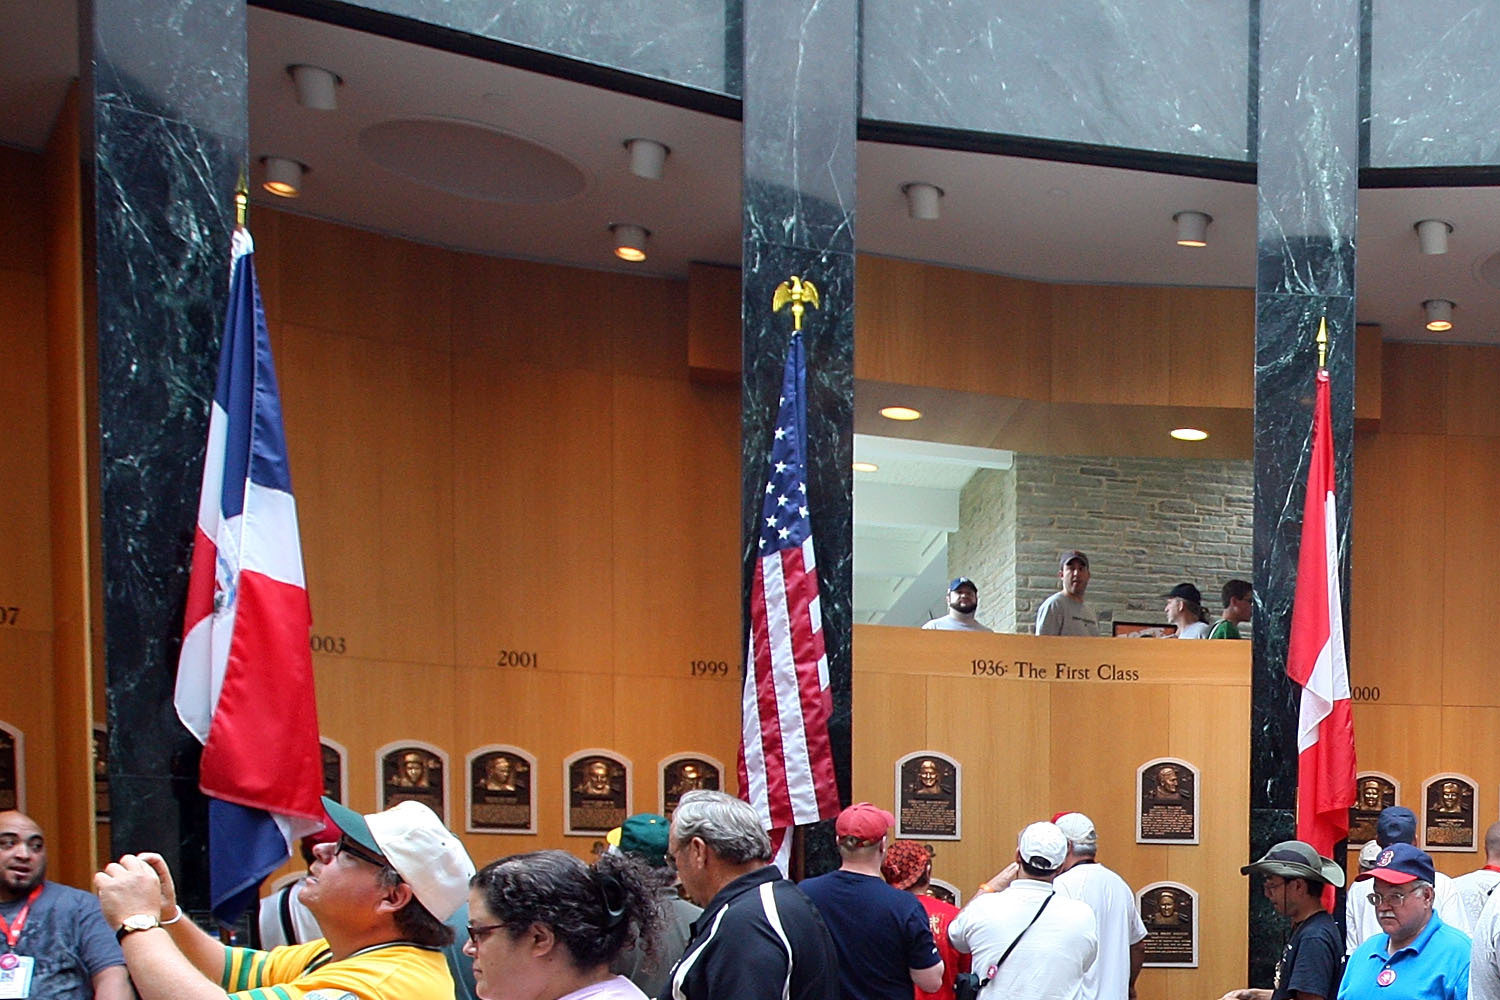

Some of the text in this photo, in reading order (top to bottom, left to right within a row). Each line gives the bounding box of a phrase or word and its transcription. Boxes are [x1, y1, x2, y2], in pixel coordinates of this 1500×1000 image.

[310, 634, 346, 654] 003
[497, 650, 538, 668] 2001
[690, 660, 729, 677] 1999
[971, 659, 1140, 681] 1936: The First Class
[1352, 686, 1381, 701] 000
